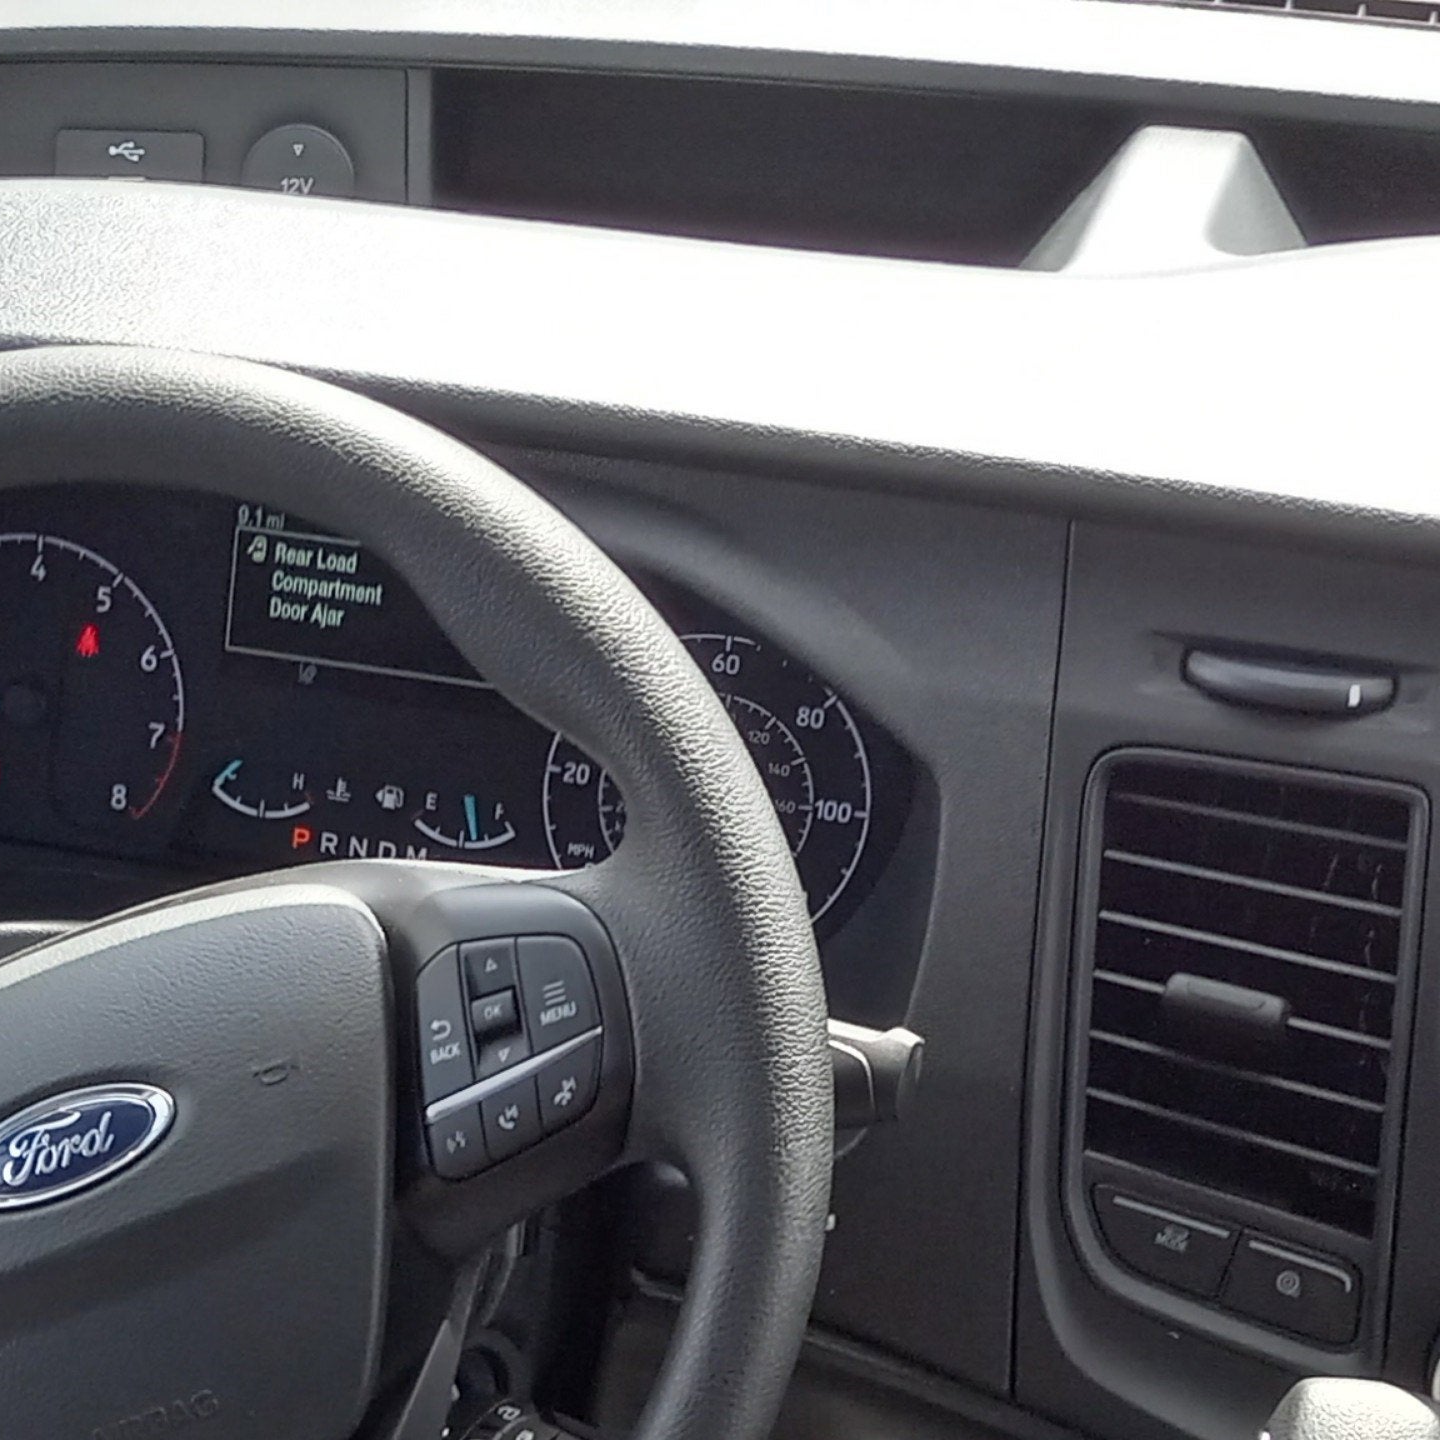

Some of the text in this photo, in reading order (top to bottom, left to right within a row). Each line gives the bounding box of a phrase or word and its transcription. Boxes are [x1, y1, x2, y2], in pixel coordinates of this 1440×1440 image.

[281, 177, 314, 195] 12V
[31, 554, 46, 582] 4
[274, 542, 358, 574] Rear Load
[96, 586, 112, 613] 5
[272, 570, 383, 606] Compartment
[270, 597, 345, 629] Door Ajar
[140, 645, 157, 672] 6
[712, 652, 740, 675] 60
[796, 706, 824, 729] 80
[148, 722, 165, 749] 7
[748, 730, 770, 745] 120
[292, 772, 305, 790] H
[563, 761, 590, 785] 20
[769, 762, 790, 777] 140
[110, 783, 127, 810] 8
[426, 792, 438, 811] E
[815, 800, 852, 824] 100
[292, 827, 310, 848] P
[320, 831, 338, 855] R
[349, 836, 368, 857] N
[483, 1003, 503, 1020] OK
[540, 1001, 578, 1027] MENU
[430, 1041, 461, 1066] BACK
[2, 1110, 115, 1187] Ford
